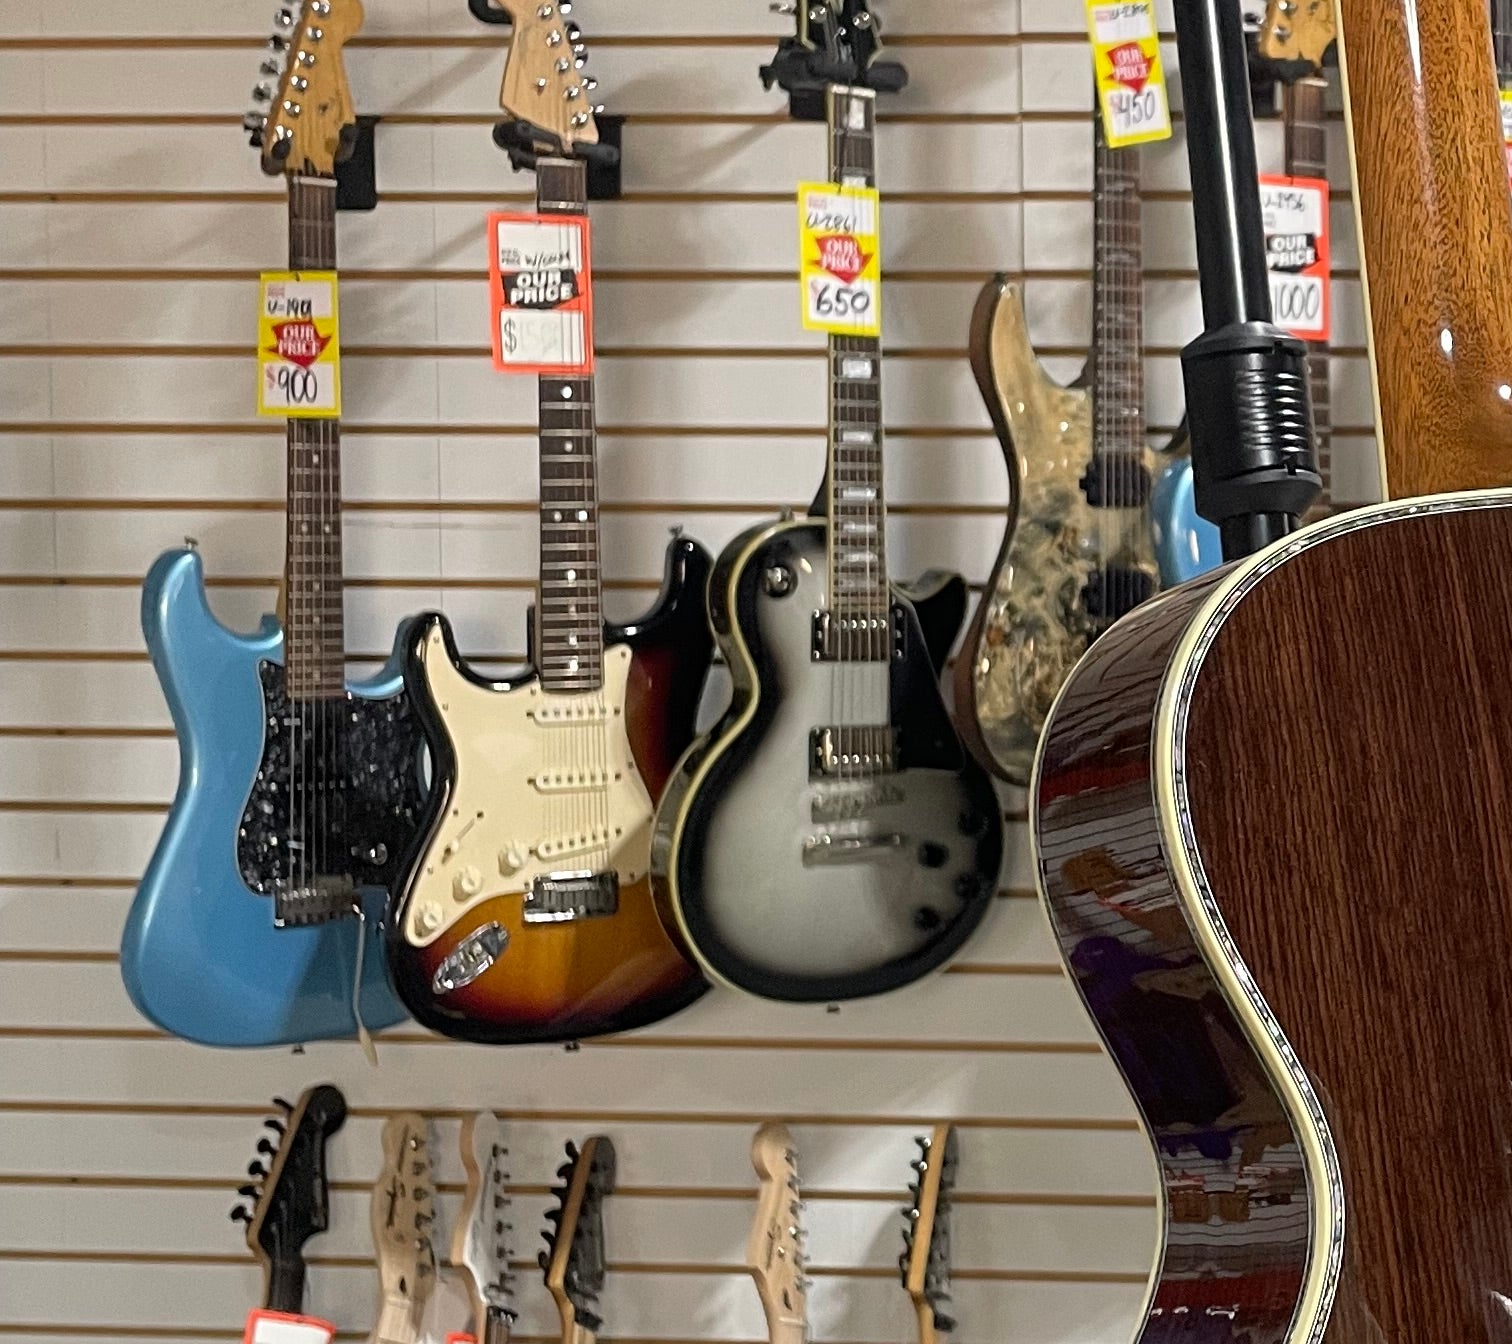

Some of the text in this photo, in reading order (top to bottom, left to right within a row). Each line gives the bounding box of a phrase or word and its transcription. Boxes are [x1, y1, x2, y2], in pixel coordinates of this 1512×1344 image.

[1116, 47, 1143, 65] OUR
[1114, 62, 1148, 82] PRICE
[826, 238, 858, 256] OUR
[1270, 234, 1308, 252] OUR
[821, 253, 862, 272] PRICE
[516, 270, 562, 289] OUR
[510, 283, 574, 306] PRICE
[282, 323, 315, 341] OUR
[277, 338, 319, 356] PRICE
